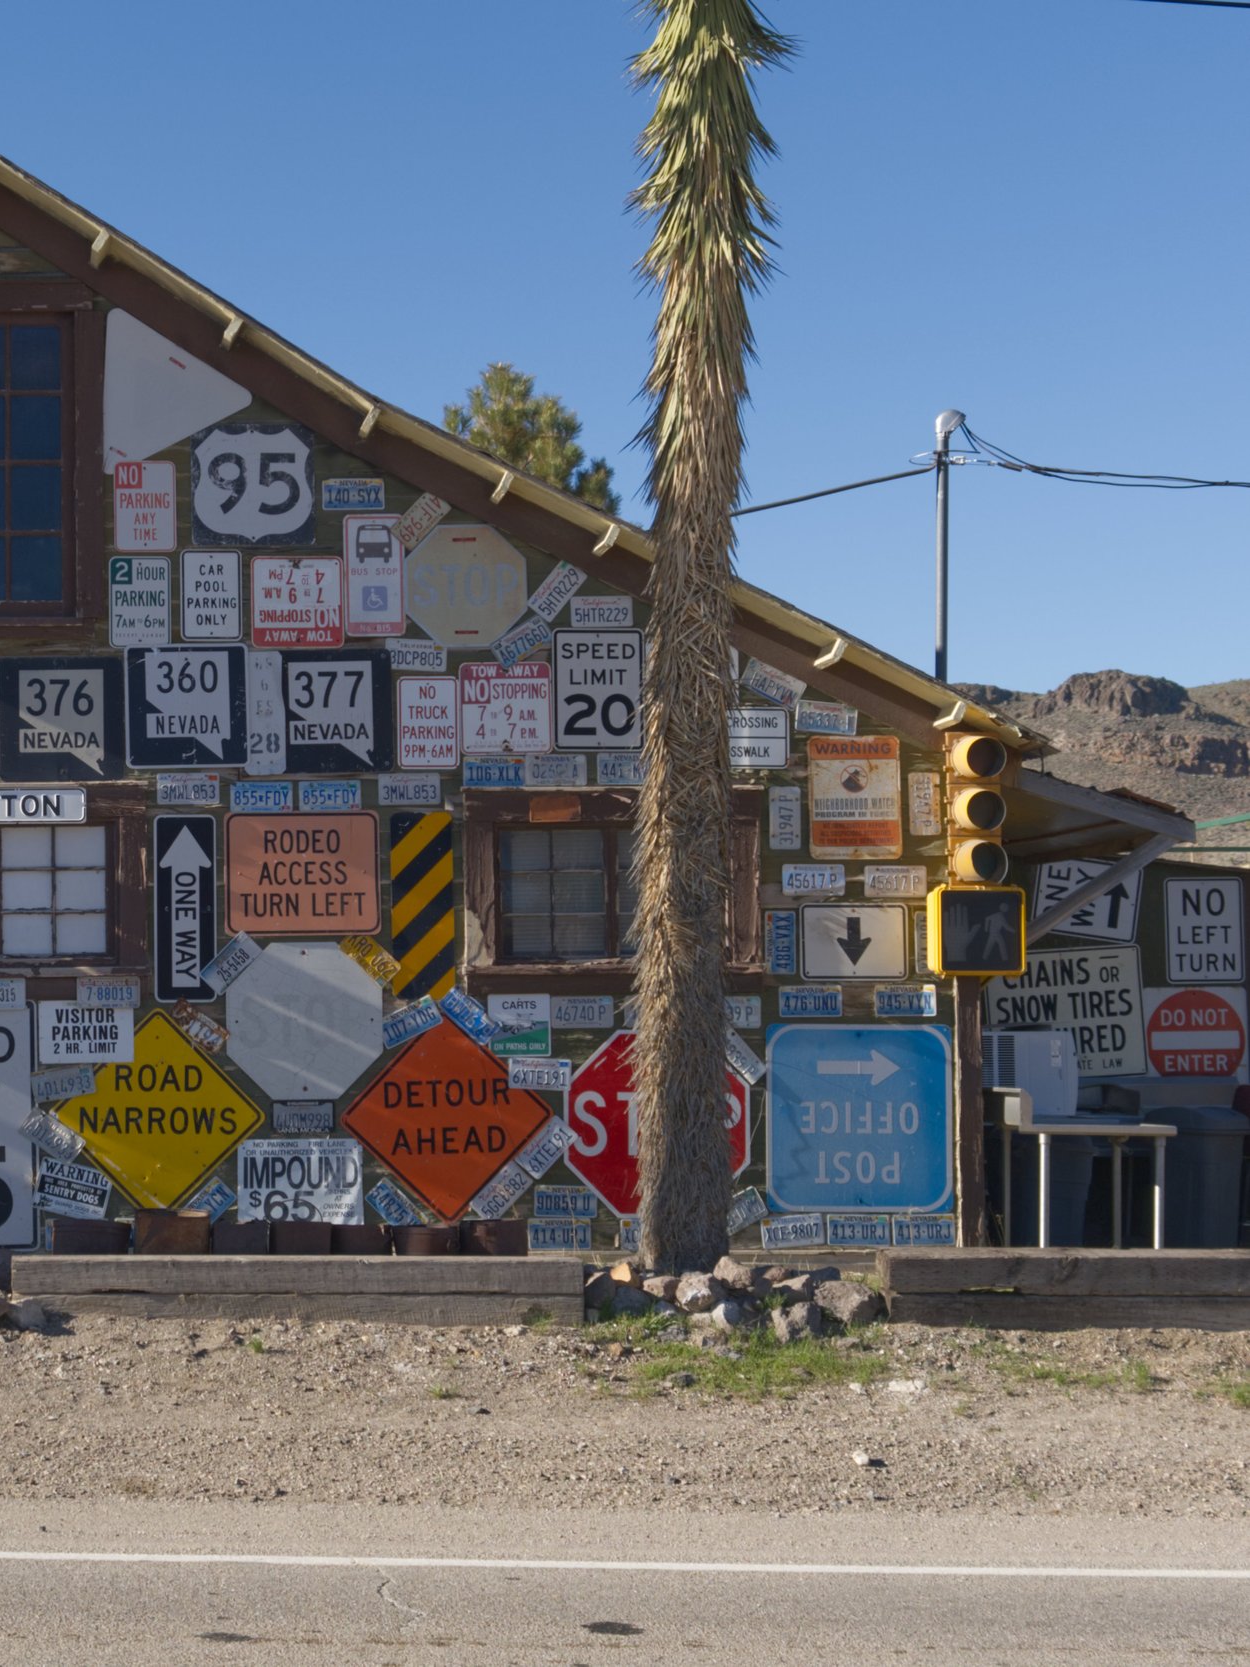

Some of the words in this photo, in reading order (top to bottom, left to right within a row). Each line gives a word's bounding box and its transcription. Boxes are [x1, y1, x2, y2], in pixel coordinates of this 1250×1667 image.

[118, 466, 139, 485] NO
[208, 452, 301, 515] 95
[119, 493, 170, 509] PARKING
[134, 512, 156, 525] ANY
[133, 528, 158, 541] TIME
[114, 561, 130, 581] 2
[136, 566, 166, 581] HOUR
[199, 564, 224, 576] CAR
[350, 567, 369, 576] BUS
[375, 567, 398, 576] STOP
[195, 581, 227, 592] POOL
[413, 562, 519, 607] STOP
[115, 590, 166, 607] PARKING
[186, 597, 237, 609] PARKING
[115, 614, 136, 628] 7AM
[144, 614, 166, 629] 6PM
[196, 614, 228, 626] ONLY
[259, 609, 311, 623] STOPPING
[316, 608, 340, 627] NO
[574, 607, 628, 625] 5HTR229
[561, 643, 635, 660] SPEED
[156, 659, 218, 693] 360
[569, 669, 627, 685] LIMIT
[25, 678, 94, 716] 376
[294, 671, 365, 708] 377
[419, 686, 436, 699] NO
[464, 680, 489, 702] NO
[493, 683, 547, 699] STOPPING
[408, 705, 448, 720] TRUCK
[478, 705, 487, 721] 7
[503, 705, 513, 721] 9
[564, 693, 635, 737] 20
[156, 715, 220, 735] NEVADA
[293, 723, 369, 741] NEVADA
[402, 725, 455, 739] PARKING
[476, 723, 485, 740] 4
[508, 723, 518, 739] 7
[23, 732, 100, 749] NEVADA
[250, 733, 281, 754] 28
[815, 743, 891, 754] WARNING
[404, 744, 454, 758] 9PM-6AM
[730, 746, 770, 758] SSWALK
[161, 784, 216, 800] 3MWL853
[382, 784, 437, 800] 3MWL853
[264, 829, 341, 854] RODEO
[259, 861, 347, 885] ACCESS
[175, 871, 197, 921] ONE
[240, 892, 299, 917] TURN
[312, 892, 366, 916] LEFT
[1182, 888, 1225, 917] NO
[1177, 926, 1232, 945] LEFT
[175, 930, 197, 980] WAY
[1175, 953, 1236, 973] TURN
[1099, 966, 1120, 984] OR
[502, 1000, 537, 1010] CARTS
[555, 1006, 594, 1022] 46740
[996, 992, 1057, 1024] SNOW
[1067, 988, 1133, 1020] TIRES
[55, 1008, 115, 1024] VISITOR
[1161, 1009, 1185, 1027] DO
[1191, 1008, 1229, 1026] NOT
[52, 1025, 118, 1041] PARKING
[53, 1043, 60, 1054] 2
[66, 1042, 83, 1054] HR.
[89, 1042, 117, 1053] LIMIT
[1102, 1058, 1123, 1069] LAW
[1164, 1054, 1229, 1073] ENTER
[114, 1064, 203, 1092] ROAD
[512, 1070, 567, 1086] 6XTE191
[383, 1078, 510, 1108] DETOUR
[79, 1107, 237, 1135] NARROWS
[800, 1101, 919, 1135] OFFICE
[391, 1125, 506, 1156] AHEAD
[44, 1159, 109, 1187] WARNING
[243, 1156, 358, 1189] IMPOUND
[814, 1151, 901, 1184] POST
[44, 1184, 76, 1199] SENTRY
[76, 1190, 100, 1205] DOGS
[766, 1223, 819, 1242] XCE-9807
